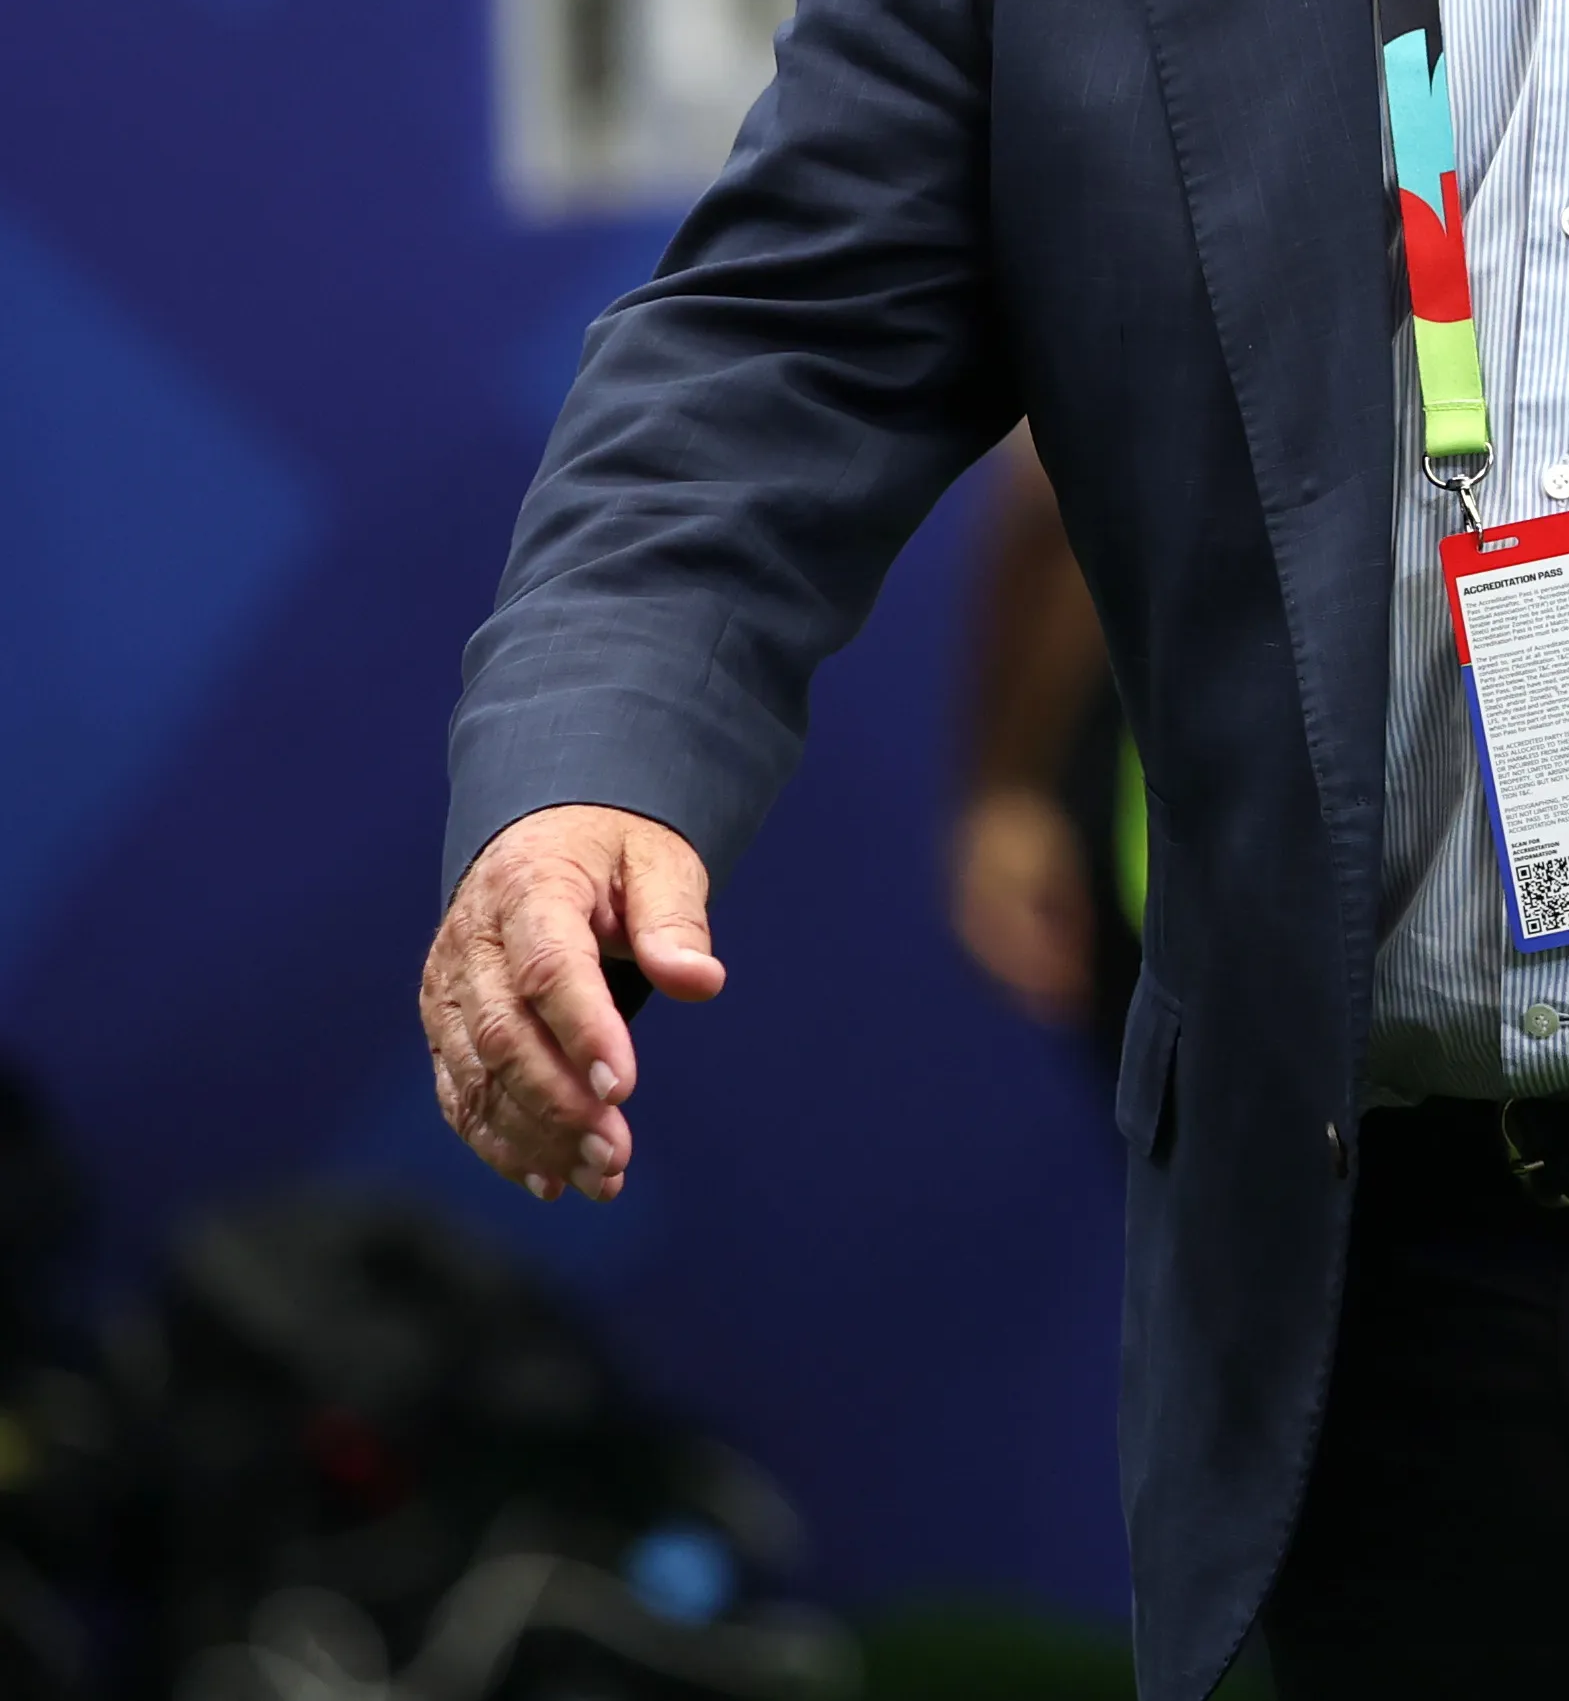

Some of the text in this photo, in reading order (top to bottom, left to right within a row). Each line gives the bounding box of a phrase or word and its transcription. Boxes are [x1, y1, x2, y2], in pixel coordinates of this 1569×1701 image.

[1462, 567, 1563, 596] ACCREDITATION PASS
[1511, 840, 1527, 848] SCAN
